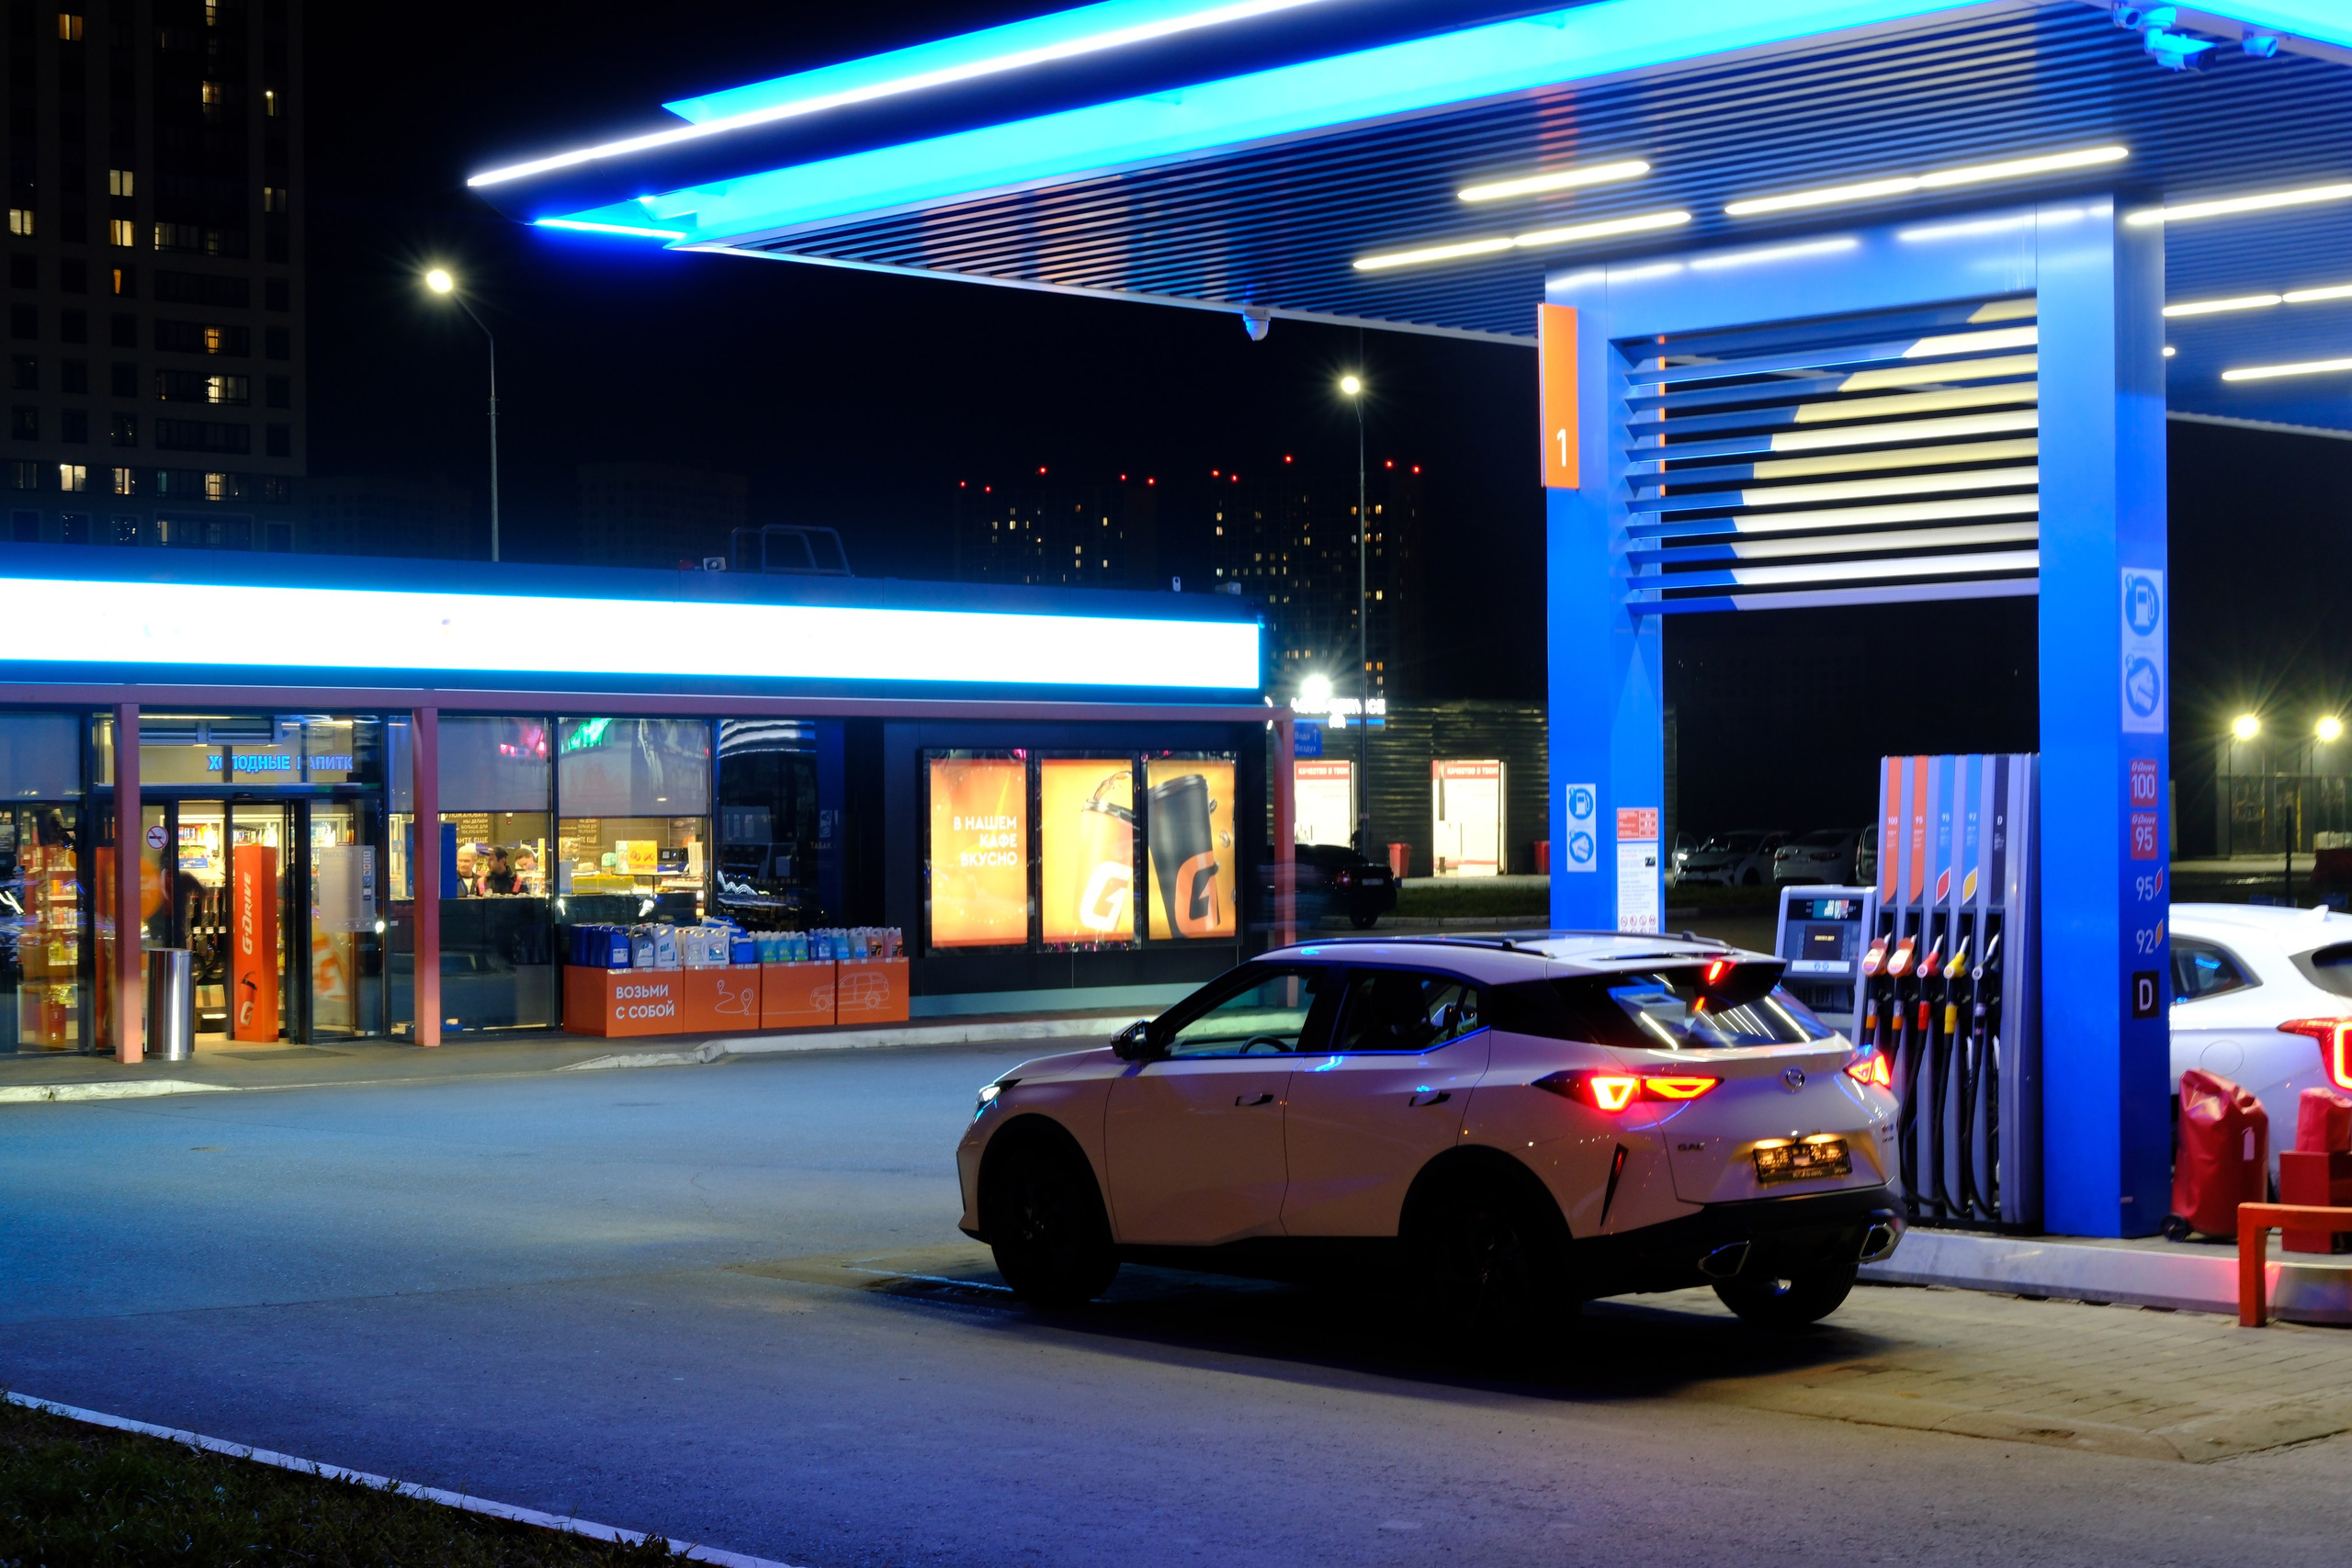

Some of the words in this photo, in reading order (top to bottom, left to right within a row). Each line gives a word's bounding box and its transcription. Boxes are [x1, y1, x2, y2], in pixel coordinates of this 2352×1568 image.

[1556, 428, 1566, 468] 1
[2132, 773, 2155, 799] 100
[954, 816, 962, 831] В
[965, 815, 1017, 830] НАШЕМ
[1888, 816, 1898, 825] 100
[979, 833, 1018, 848] КАФЕ
[2135, 826, 2154, 852] 95
[961, 852, 1018, 867] ВКУСНО
[2135, 875, 2154, 902] 95
[2135, 929, 2154, 954] 92
[616, 984, 669, 999] ВОЗЬМИ
[2139, 978, 2153, 1011] D
[616, 1006, 626, 1020] С
[628, 999, 674, 1019] СОБОЙ
